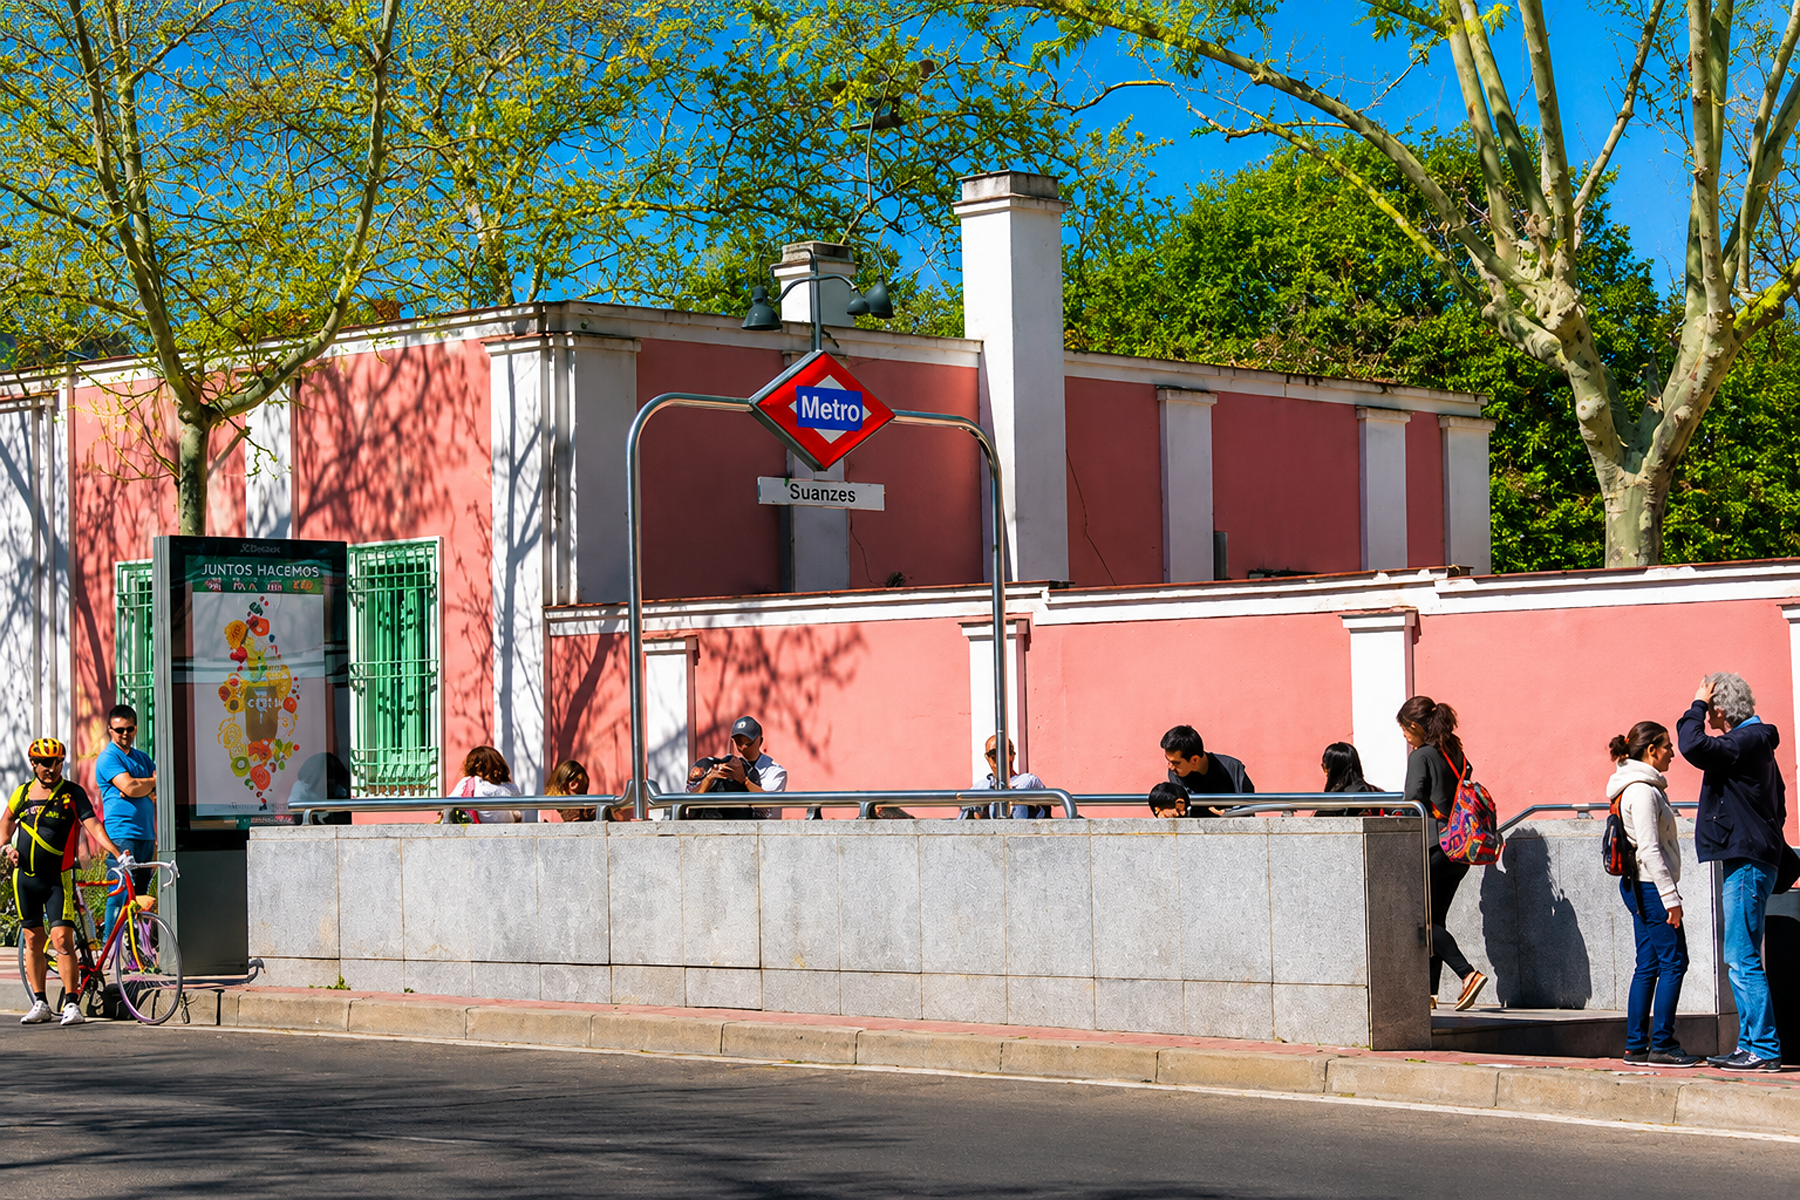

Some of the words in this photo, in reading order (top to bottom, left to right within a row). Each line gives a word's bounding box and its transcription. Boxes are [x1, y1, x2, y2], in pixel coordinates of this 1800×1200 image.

[801, 395, 860, 422] Metro
[789, 483, 856, 503] Suanzes
[201, 563, 253, 576] JUNTOS
[257, 564, 320, 578] HACEMOS
